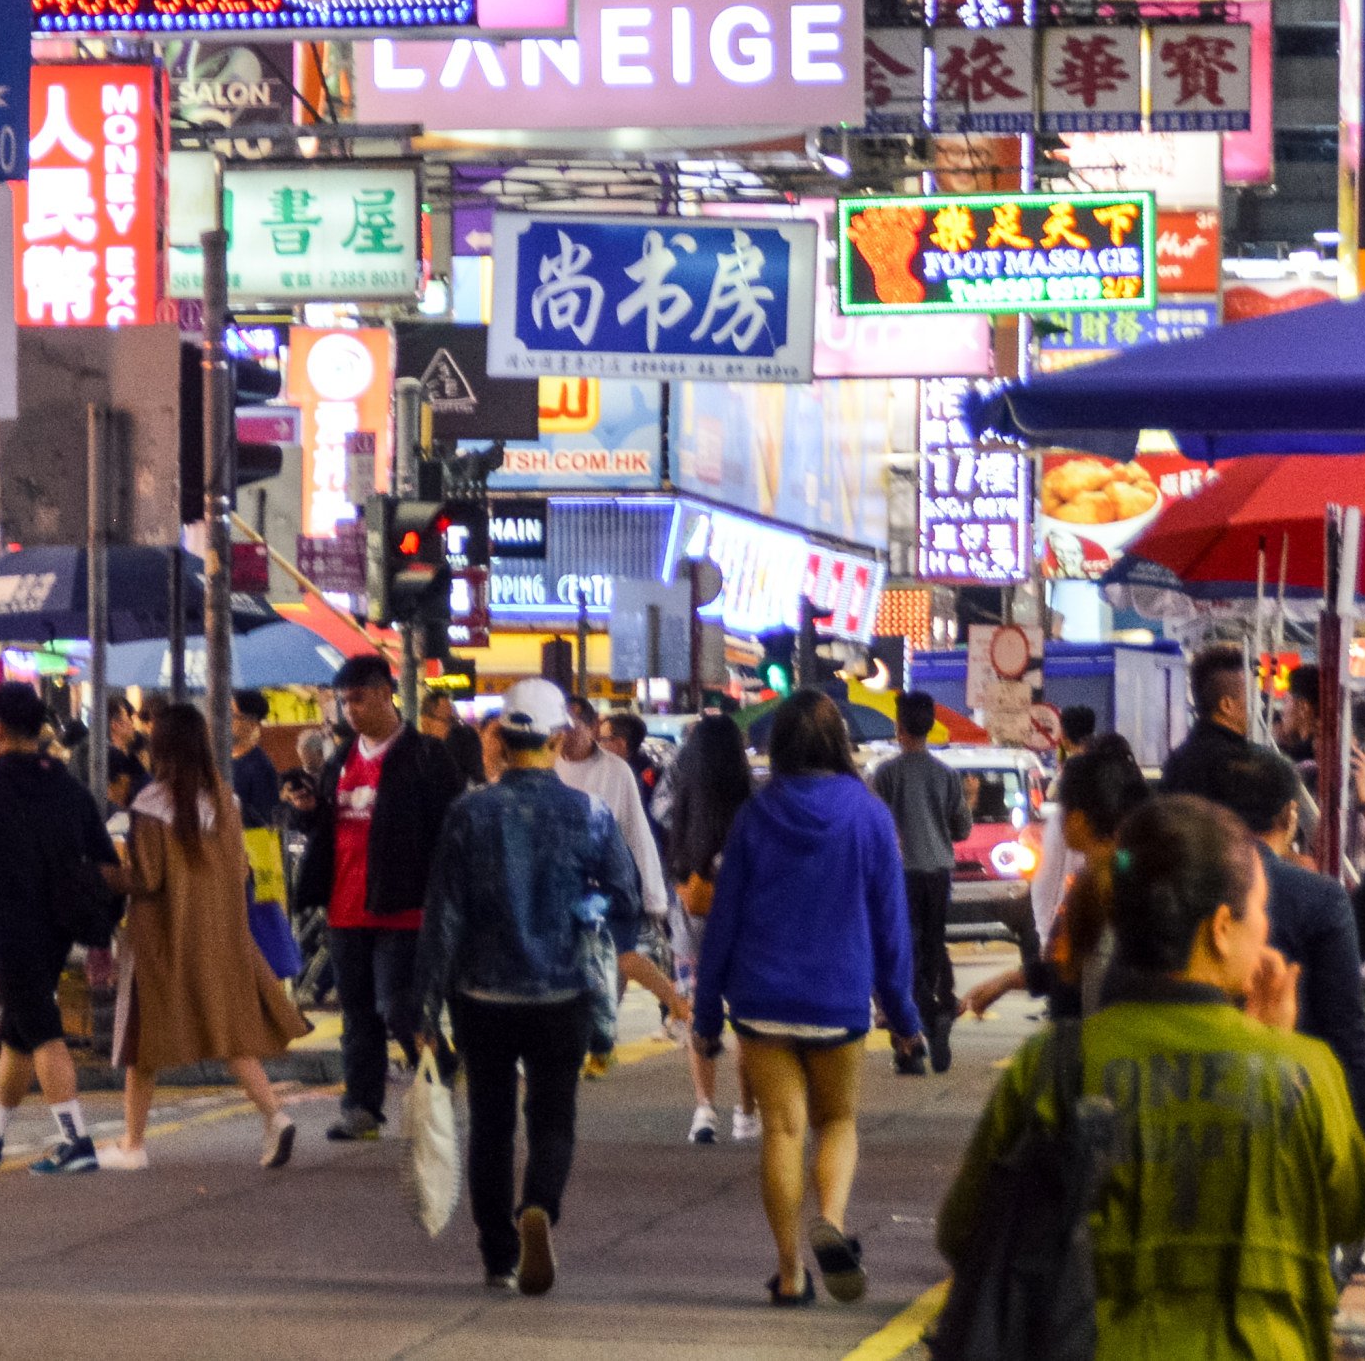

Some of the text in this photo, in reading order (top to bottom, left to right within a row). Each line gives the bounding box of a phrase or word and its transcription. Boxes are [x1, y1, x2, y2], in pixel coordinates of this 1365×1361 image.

[372, 3, 846, 90] LANEIGE
[179, 80, 271, 106] SALON
[101, 83, 140, 235] MONEY
[260, 184, 406, 256] 書屋
[922, 247, 1141, 279] FOOT MASSAGE
